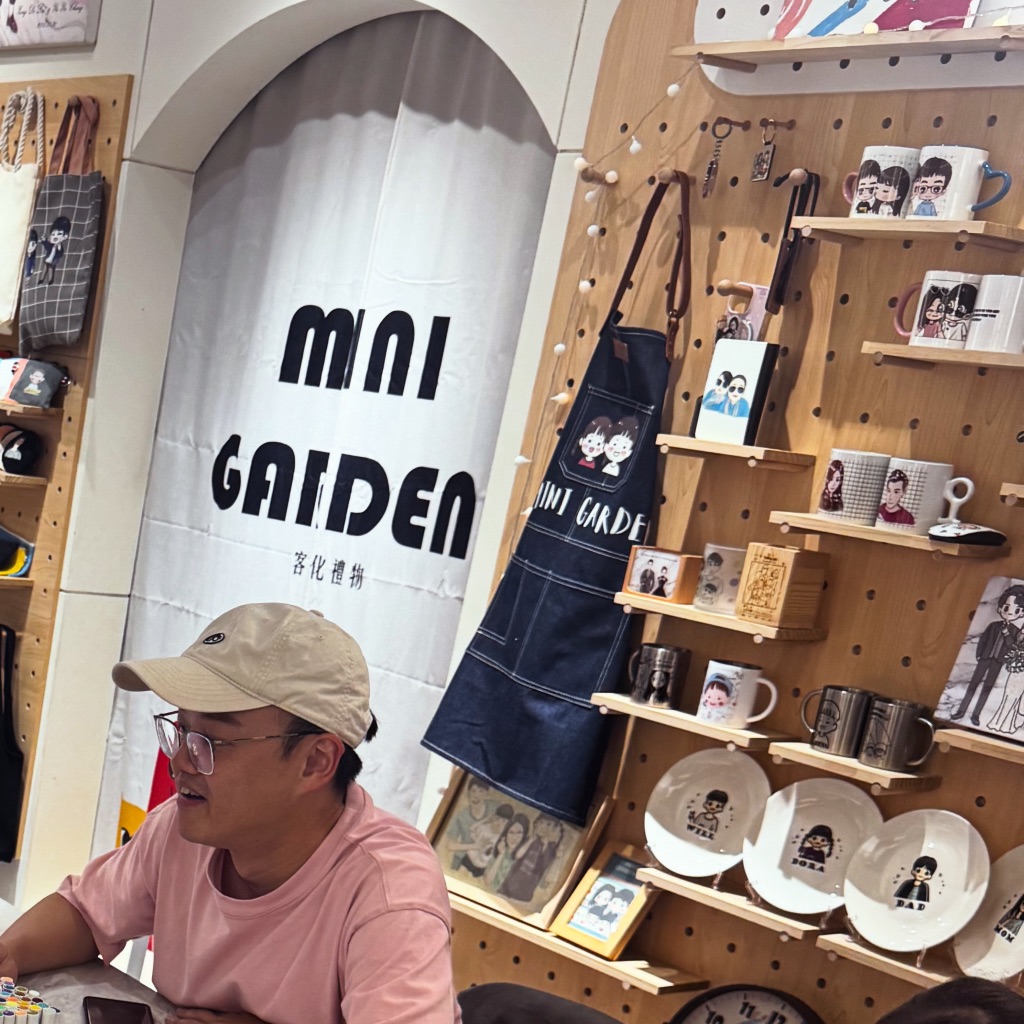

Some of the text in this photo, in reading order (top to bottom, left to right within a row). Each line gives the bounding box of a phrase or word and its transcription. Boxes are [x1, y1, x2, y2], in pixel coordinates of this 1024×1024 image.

[293, 550, 365, 591] 客化禮物
[686, 823, 715, 841] WILL
[895, 899, 926, 911] DAD
[993, 924, 1016, 944] MOM
[739, 1001, 756, 1019] 11
